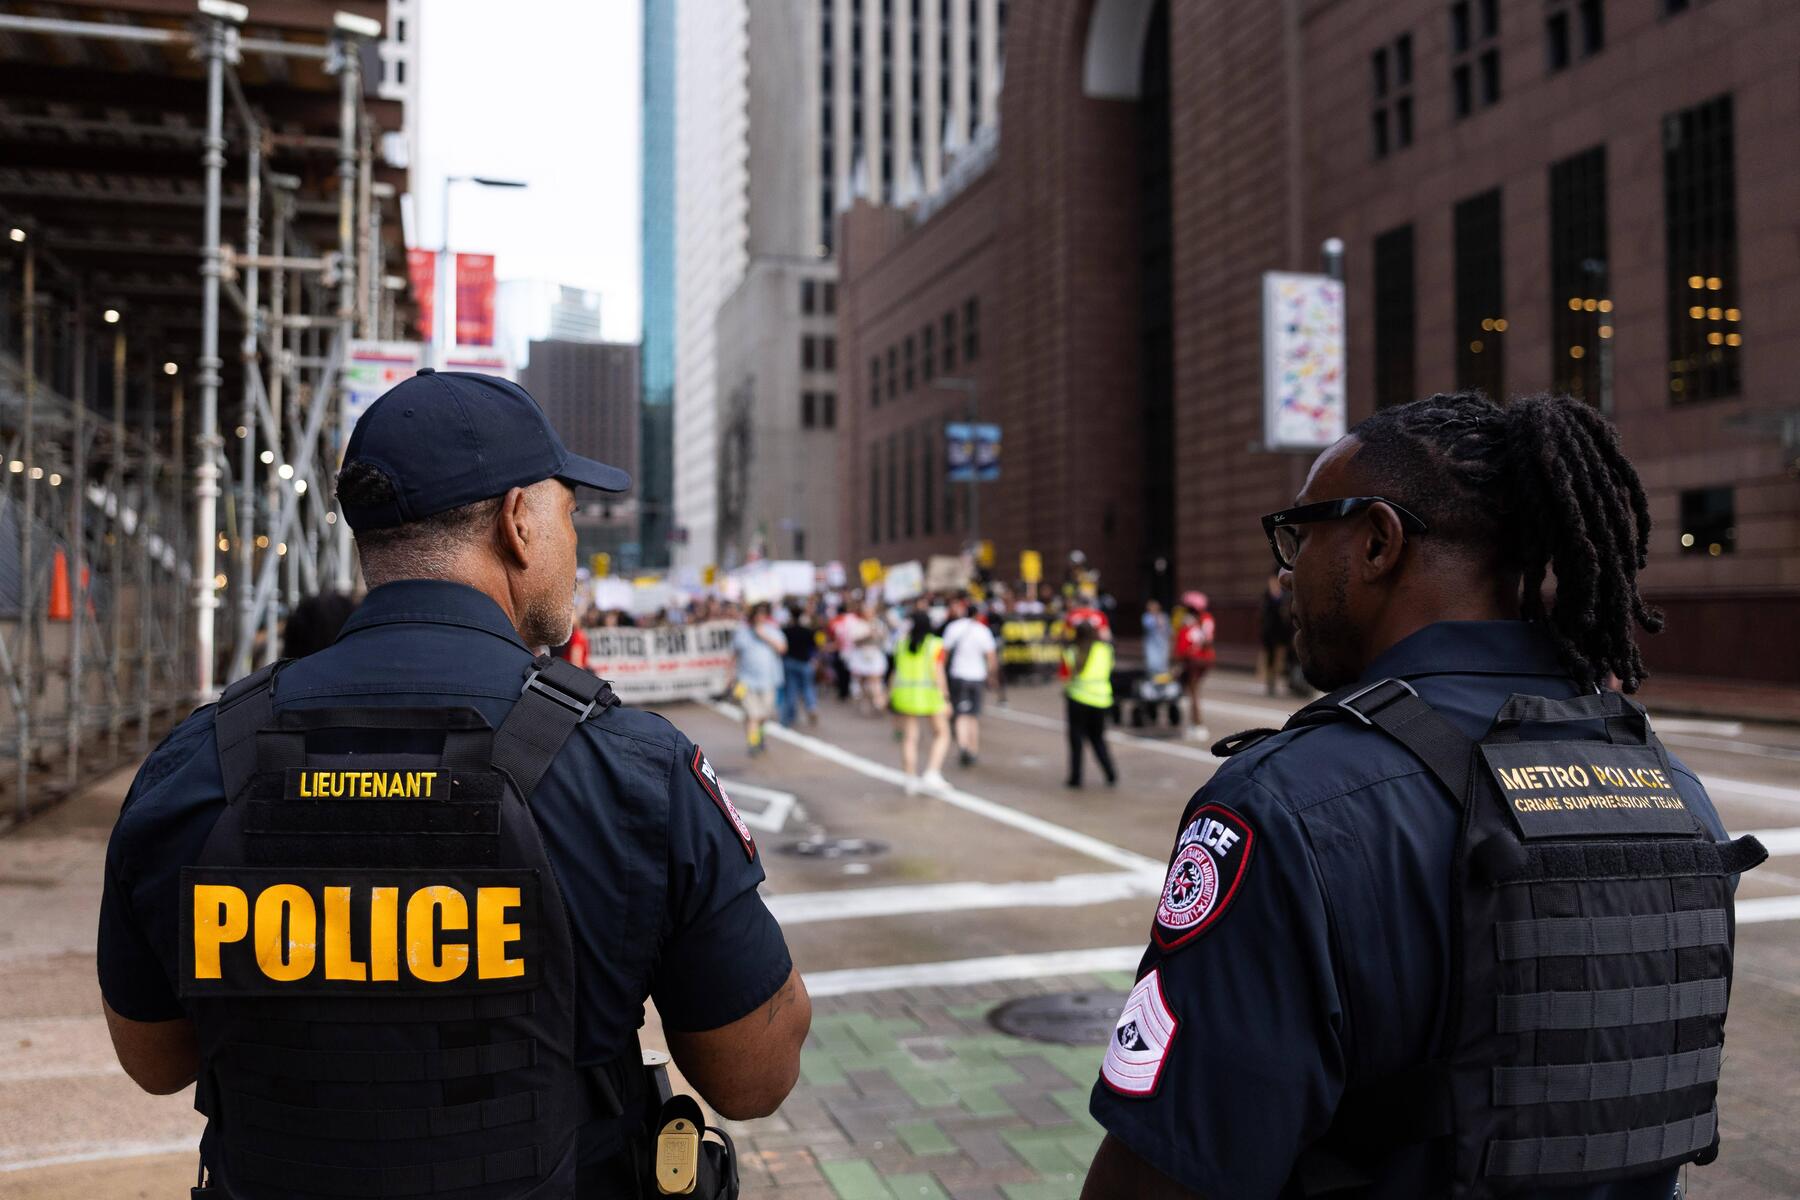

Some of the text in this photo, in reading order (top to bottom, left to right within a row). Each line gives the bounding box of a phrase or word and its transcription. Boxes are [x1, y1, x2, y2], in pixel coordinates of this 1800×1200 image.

[300, 772, 438, 798] LIEUTENANT
[1498, 764, 1672, 790] METRO POLICE
[1514, 795, 1685, 812] CRIME SUPPRESSION TEAM
[1177, 817, 1241, 858] POLICE
[1170, 907, 1199, 926] COUNTY
[194, 883, 526, 983] POLICE
